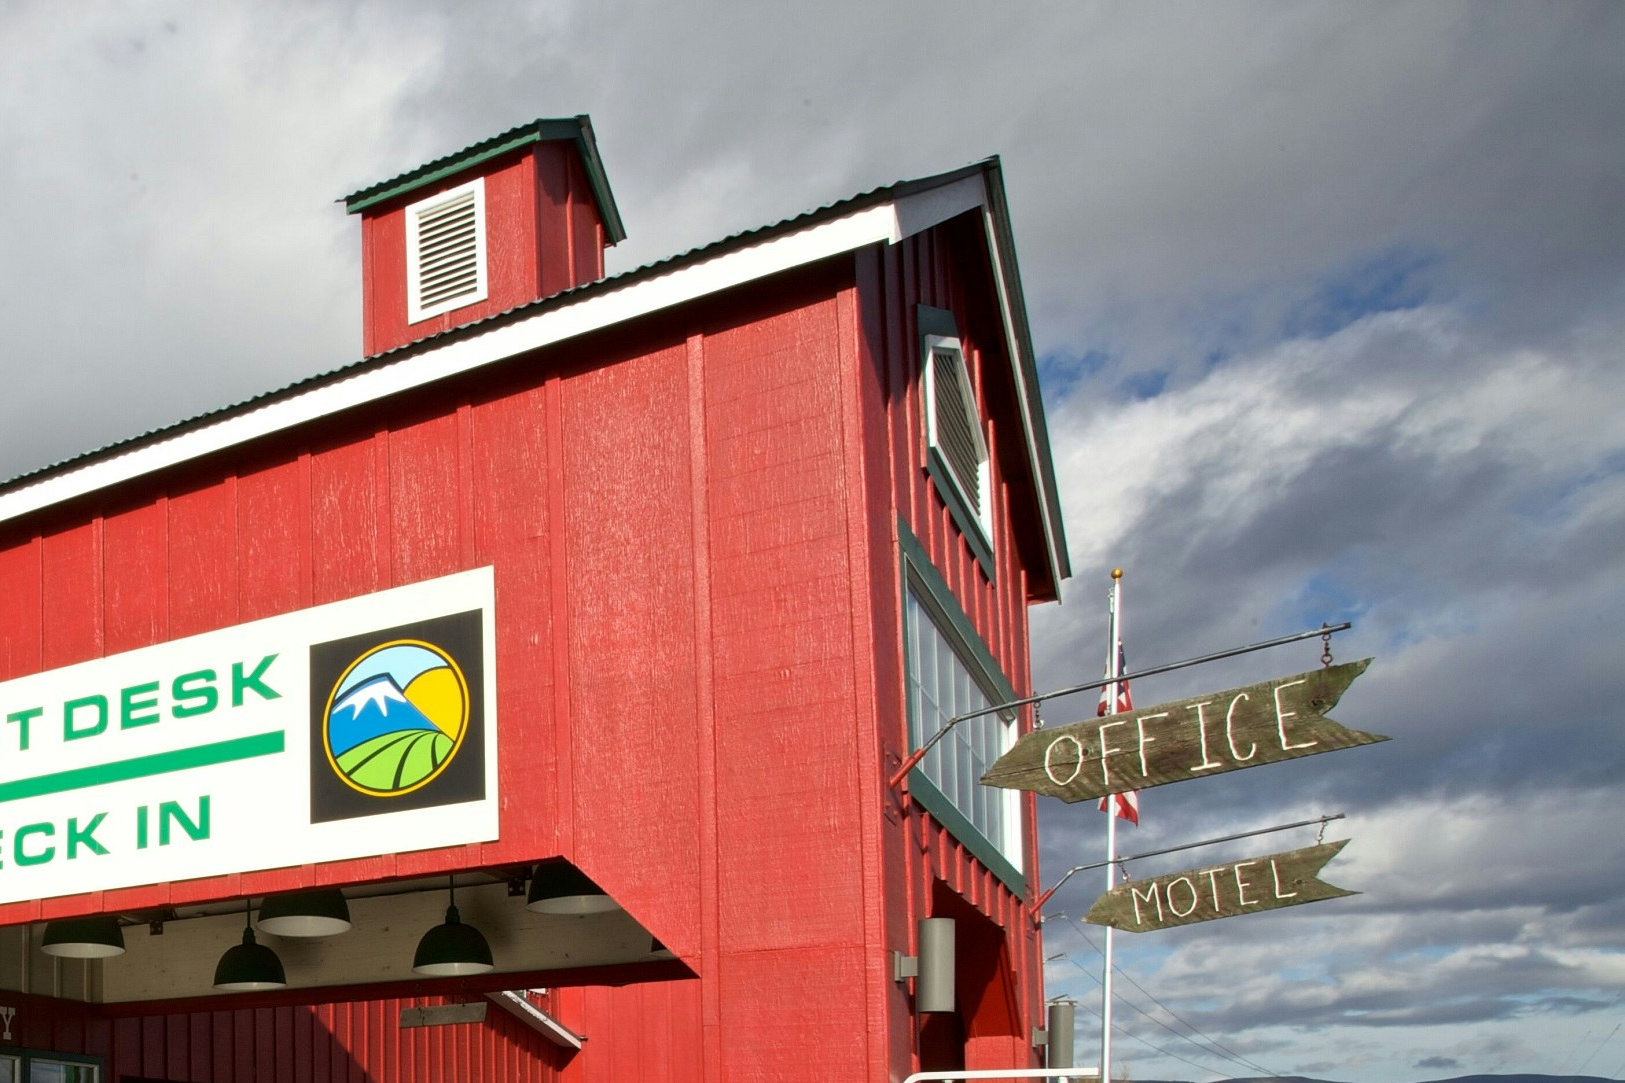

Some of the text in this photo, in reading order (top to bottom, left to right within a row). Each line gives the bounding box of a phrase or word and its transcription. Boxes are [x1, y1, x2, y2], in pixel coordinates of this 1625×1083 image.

[64, 653, 282, 742] DESK
[1045, 680, 1318, 785] OFFICE
[136, 795, 211, 850] IN
[1131, 859, 1297, 925] MOTEL
